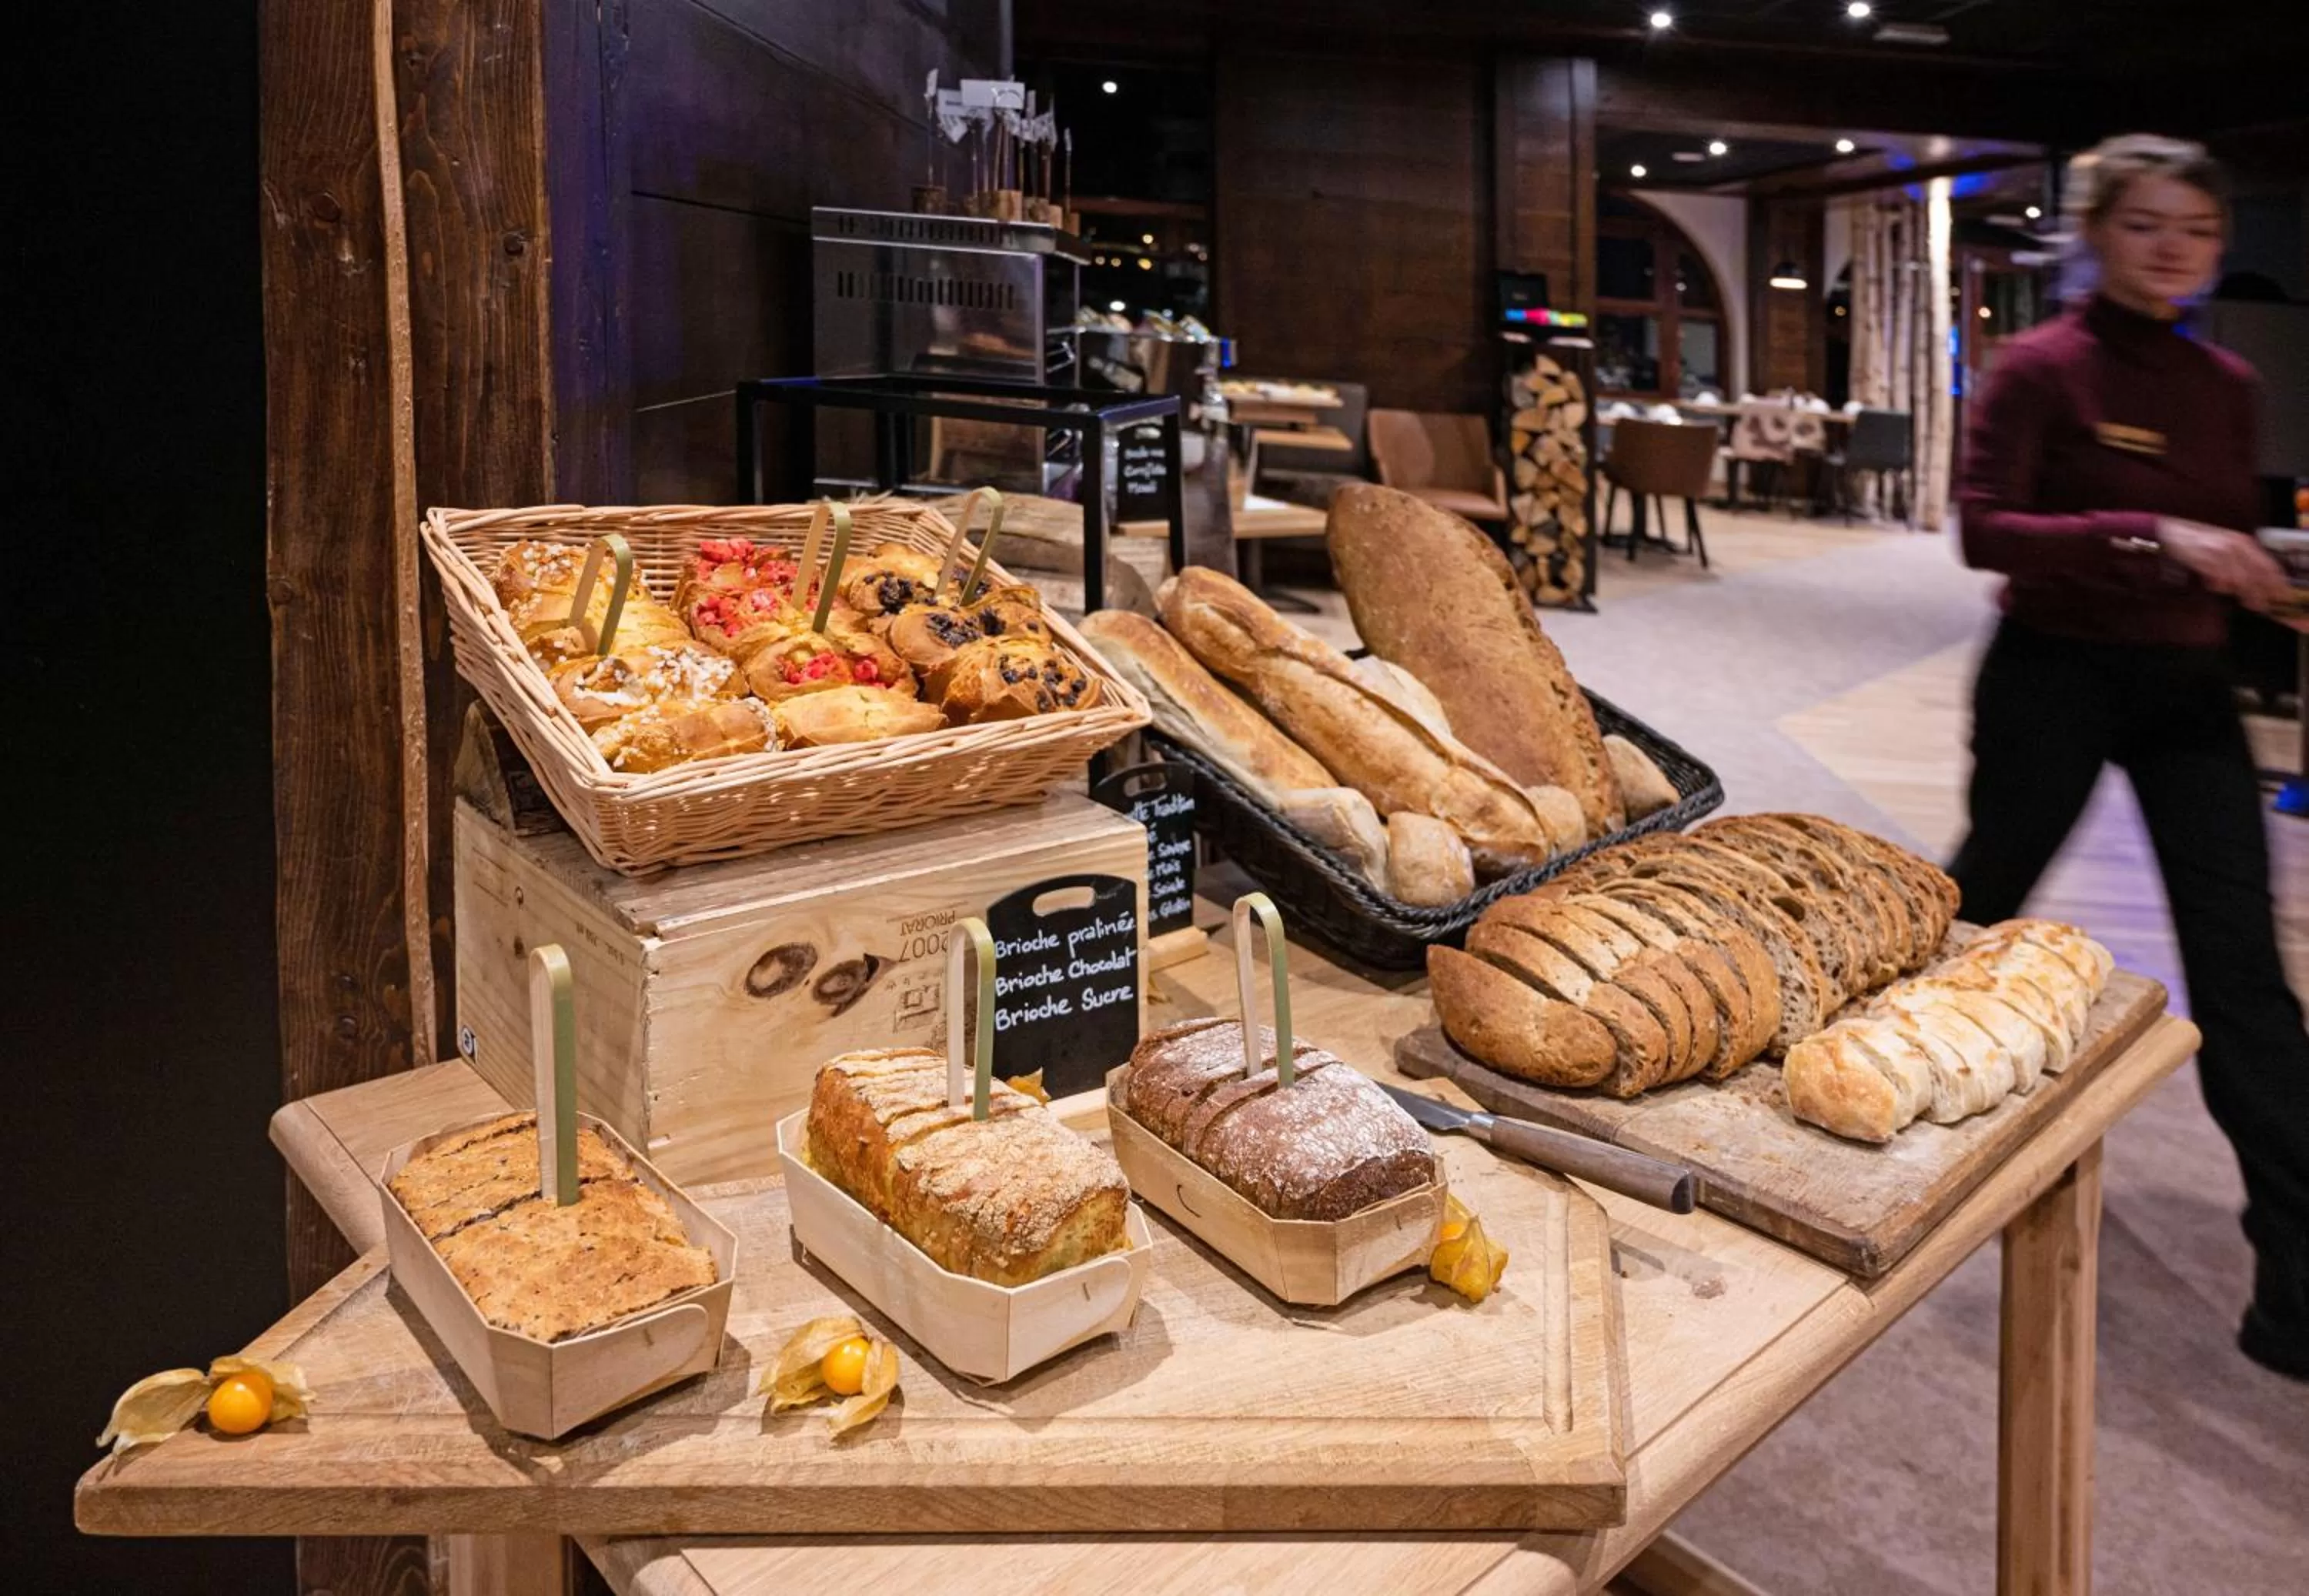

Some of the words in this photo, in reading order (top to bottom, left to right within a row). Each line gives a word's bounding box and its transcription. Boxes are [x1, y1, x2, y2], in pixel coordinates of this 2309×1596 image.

[900, 910, 955, 936] PRIORAT
[994, 929, 1060, 959] Brioche
[994, 963, 1064, 997] Brioche
[1068, 947, 1137, 978] Chocolat
[995, 994, 1073, 1030] Brioche
[1081, 985, 1134, 1010] Sucre
